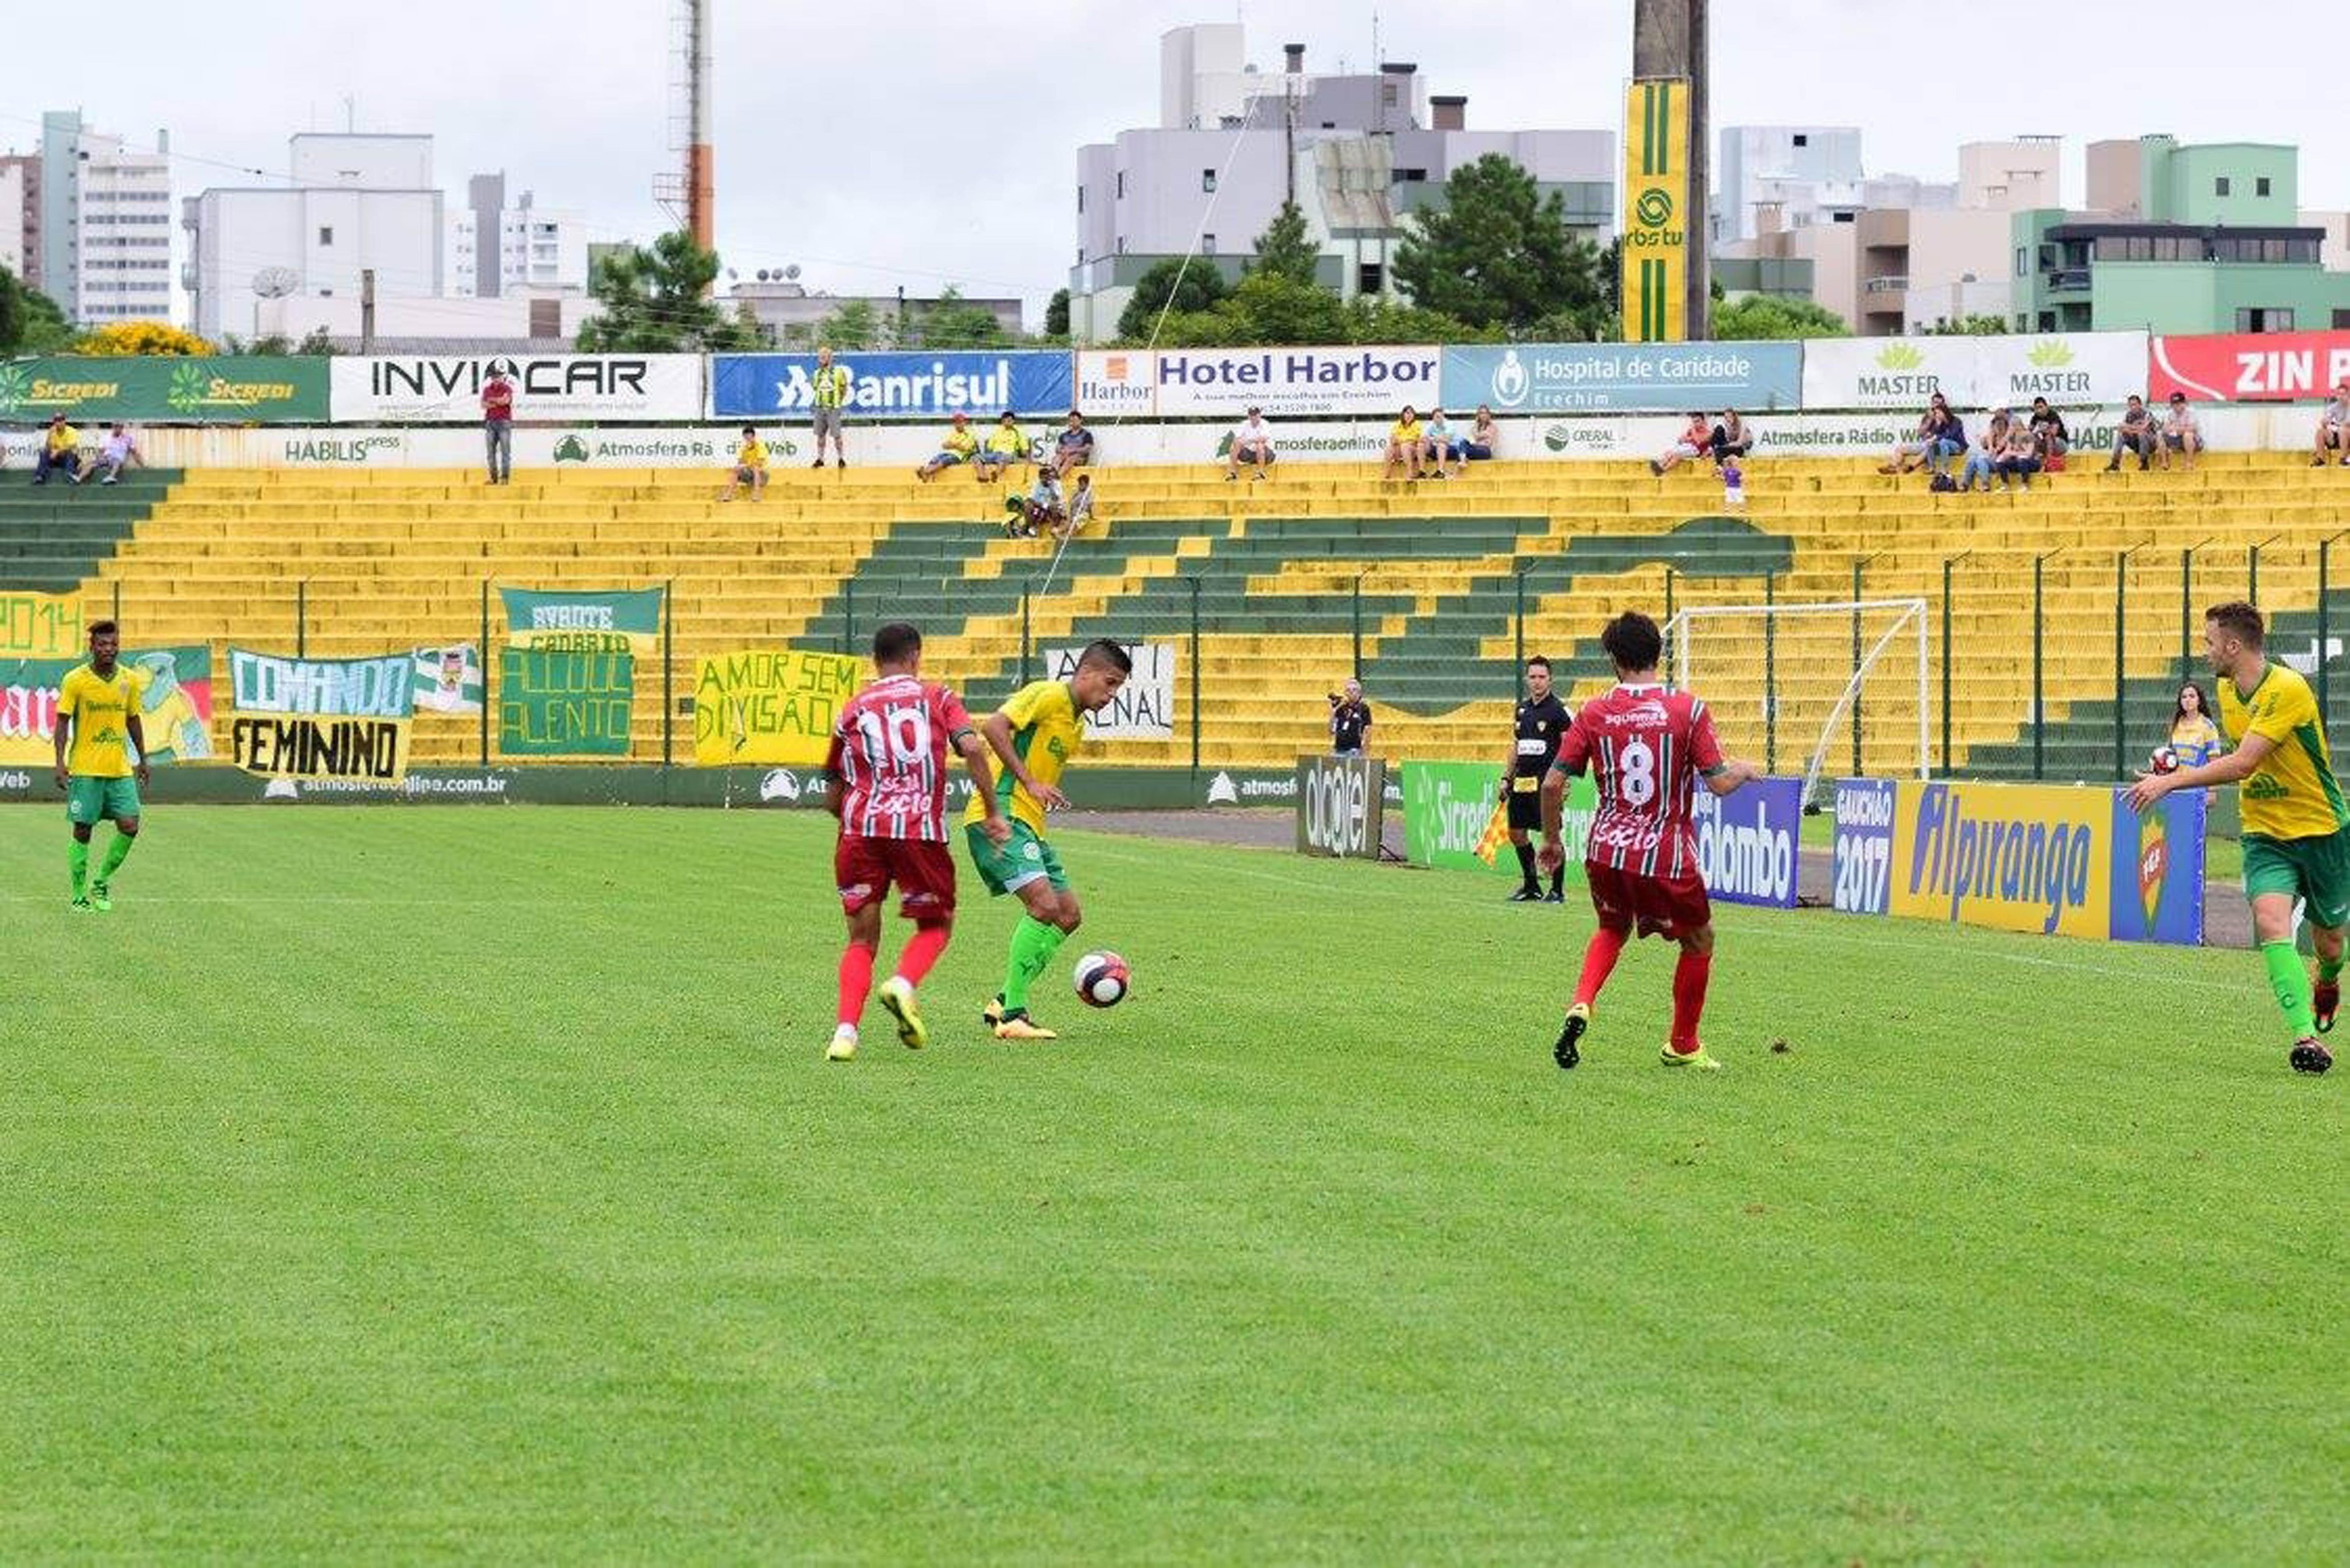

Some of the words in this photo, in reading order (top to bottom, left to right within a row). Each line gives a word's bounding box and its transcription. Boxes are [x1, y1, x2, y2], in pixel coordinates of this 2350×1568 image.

[1160, 355, 1271, 385] Hotel
[1288, 353, 1437, 384] Harbor
[1535, 358, 1620, 383] Hospital
[1627, 358, 1651, 378] de
[1660, 355, 1750, 378] Caridade
[1858, 375, 1939, 395] MASTER
[2011, 371, 2090, 392] MASTER
[2236, 350, 2313, 392] ZIN
[1082, 382, 1152, 400] Harbor
[1534, 390, 1609, 406] Erechim
[597, 441, 687, 457] Atmosfera
[1274, 435, 1387, 450] mosferaonline
[1760, 428, 1845, 446] Atmosfera
[1849, 427, 1895, 444] Rádio
[231, 651, 412, 716] COMANDO
[698, 653, 789, 695] AMOR
[798, 654, 856, 696] SEM
[501, 698, 632, 743] ALENTO
[696, 691, 832, 744] DIVISÃO
[859, 706, 929, 766] 10
[233, 717, 398, 778] FEMININO
[1621, 741, 1655, 805] 8
[1837, 782, 1892, 827] GAUCHÃO
[1698, 796, 1791, 902] olombo
[1942, 794, 2092, 935] Ipiranga
[1835, 833, 1891, 913] 2017
